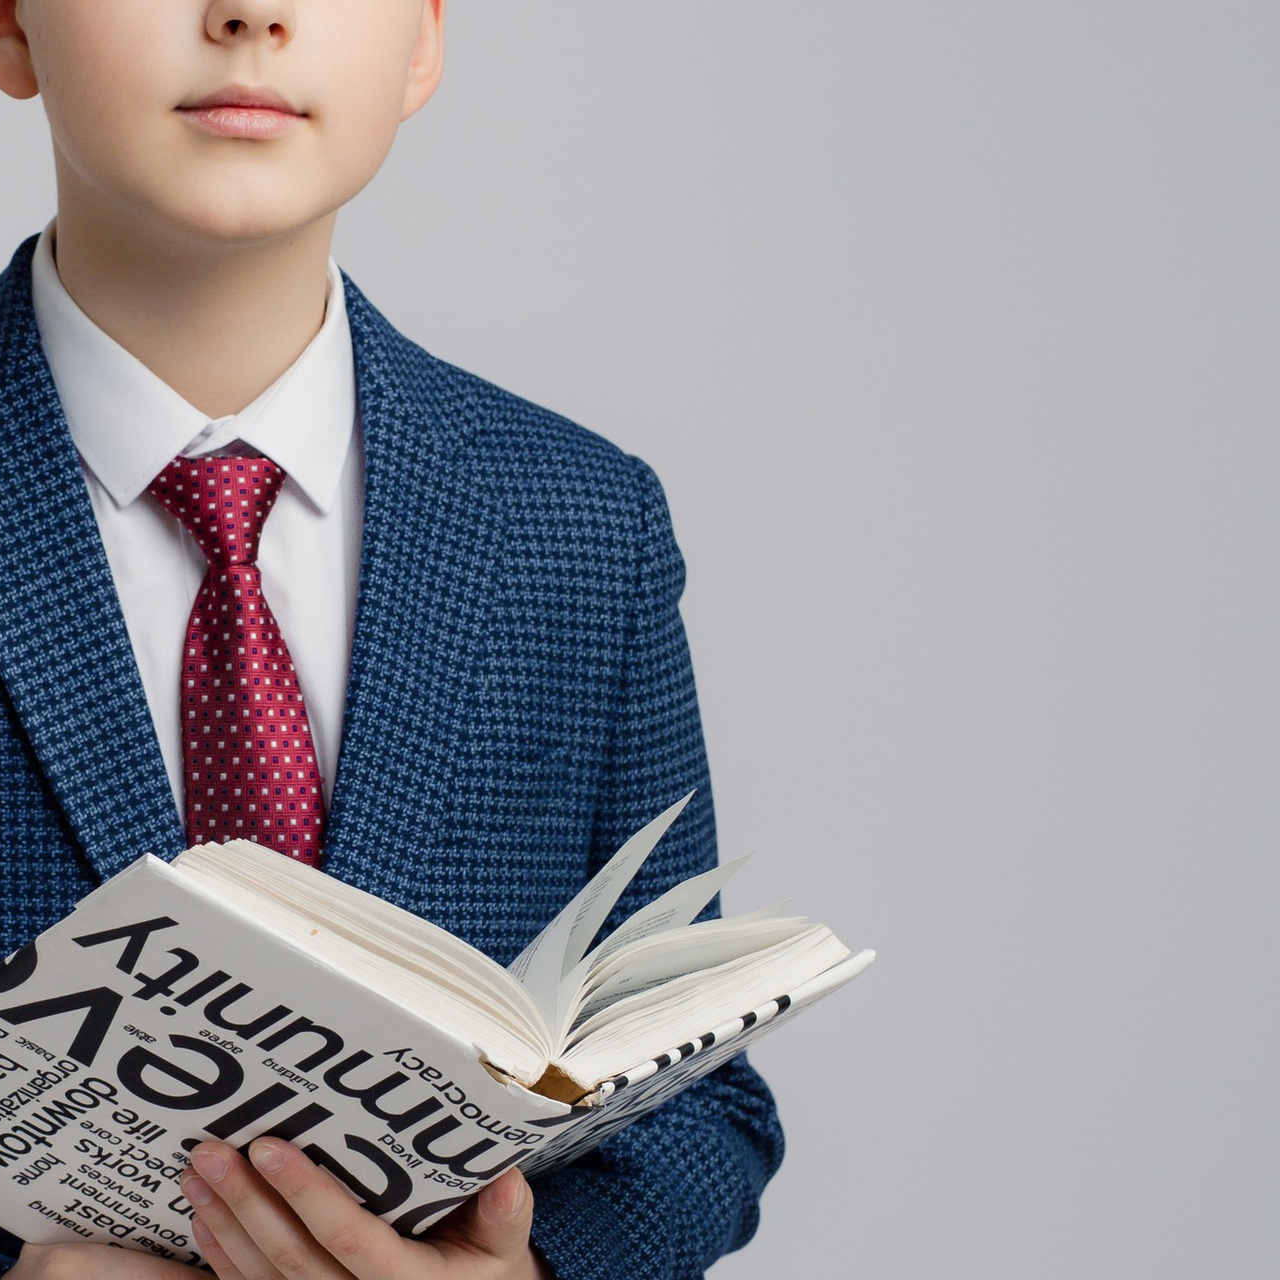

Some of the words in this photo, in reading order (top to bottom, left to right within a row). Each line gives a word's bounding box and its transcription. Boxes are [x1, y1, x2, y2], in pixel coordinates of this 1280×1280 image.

[14, 1036, 57, 1063] basic
[198, 1029, 244, 1055] agree
[385, 1048, 545, 1147] democracy
[79, 1120, 120, 1146] core
[111, 1108, 168, 1145] life
[11, 1152, 67, 1186] home
[73, 1138, 162, 1194] works
[377, 1133, 424, 1169] lived
[77, 1163, 155, 1209] services
[423, 1168, 477, 1193] best
[27, 1200, 96, 1245] making
[58, 1172, 190, 1254] government
[63, 1198, 138, 1245] past
